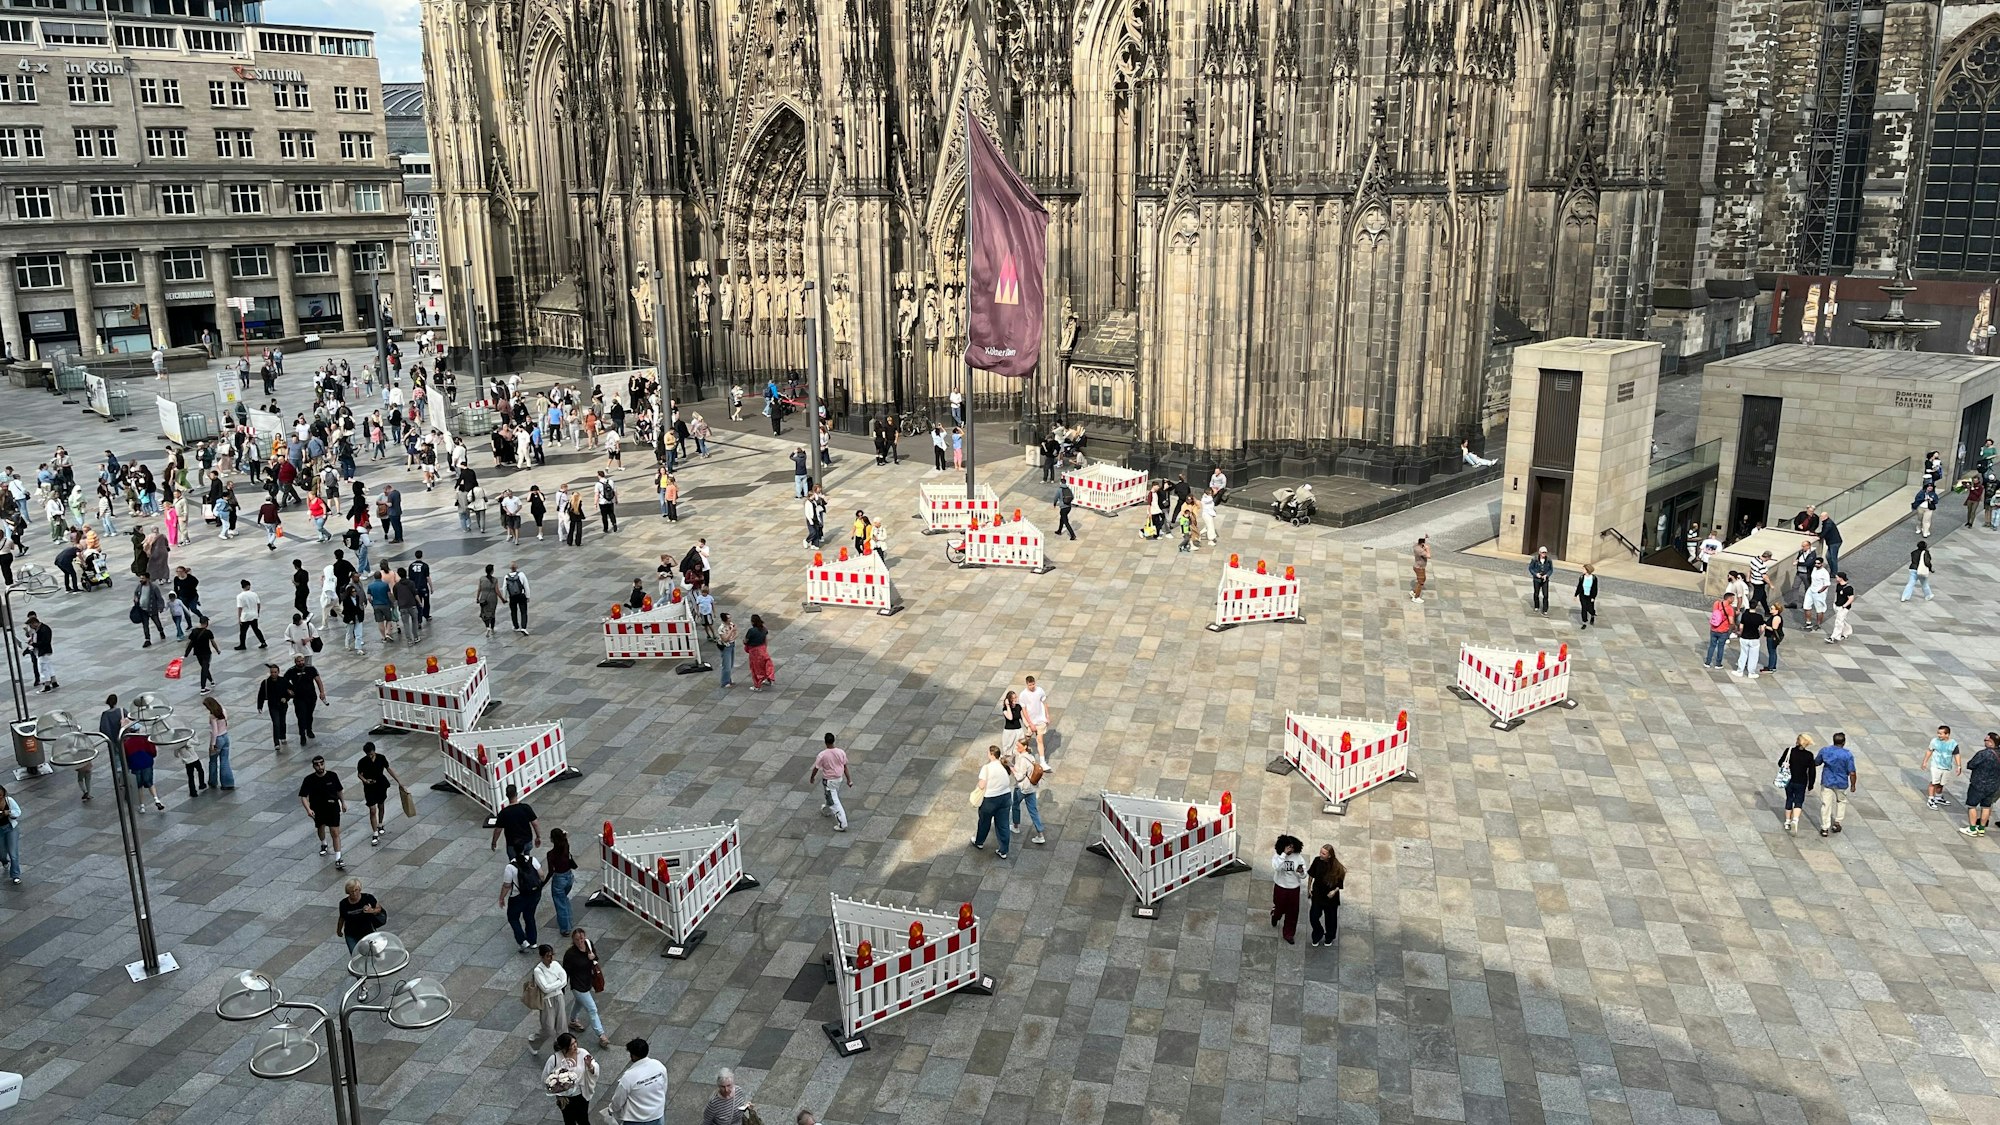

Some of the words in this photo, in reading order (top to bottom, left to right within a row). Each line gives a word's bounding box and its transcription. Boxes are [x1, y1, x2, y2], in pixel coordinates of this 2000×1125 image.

[18, 58, 31, 73] 4
[37, 62, 48, 73] x
[64, 60, 80, 74] in
[86, 60, 124, 75] Köln
[254, 68, 302, 82] SATURN
[1895, 396, 1932, 404] PARKHAUS
[1895, 401, 1932, 409] TOILETEN
